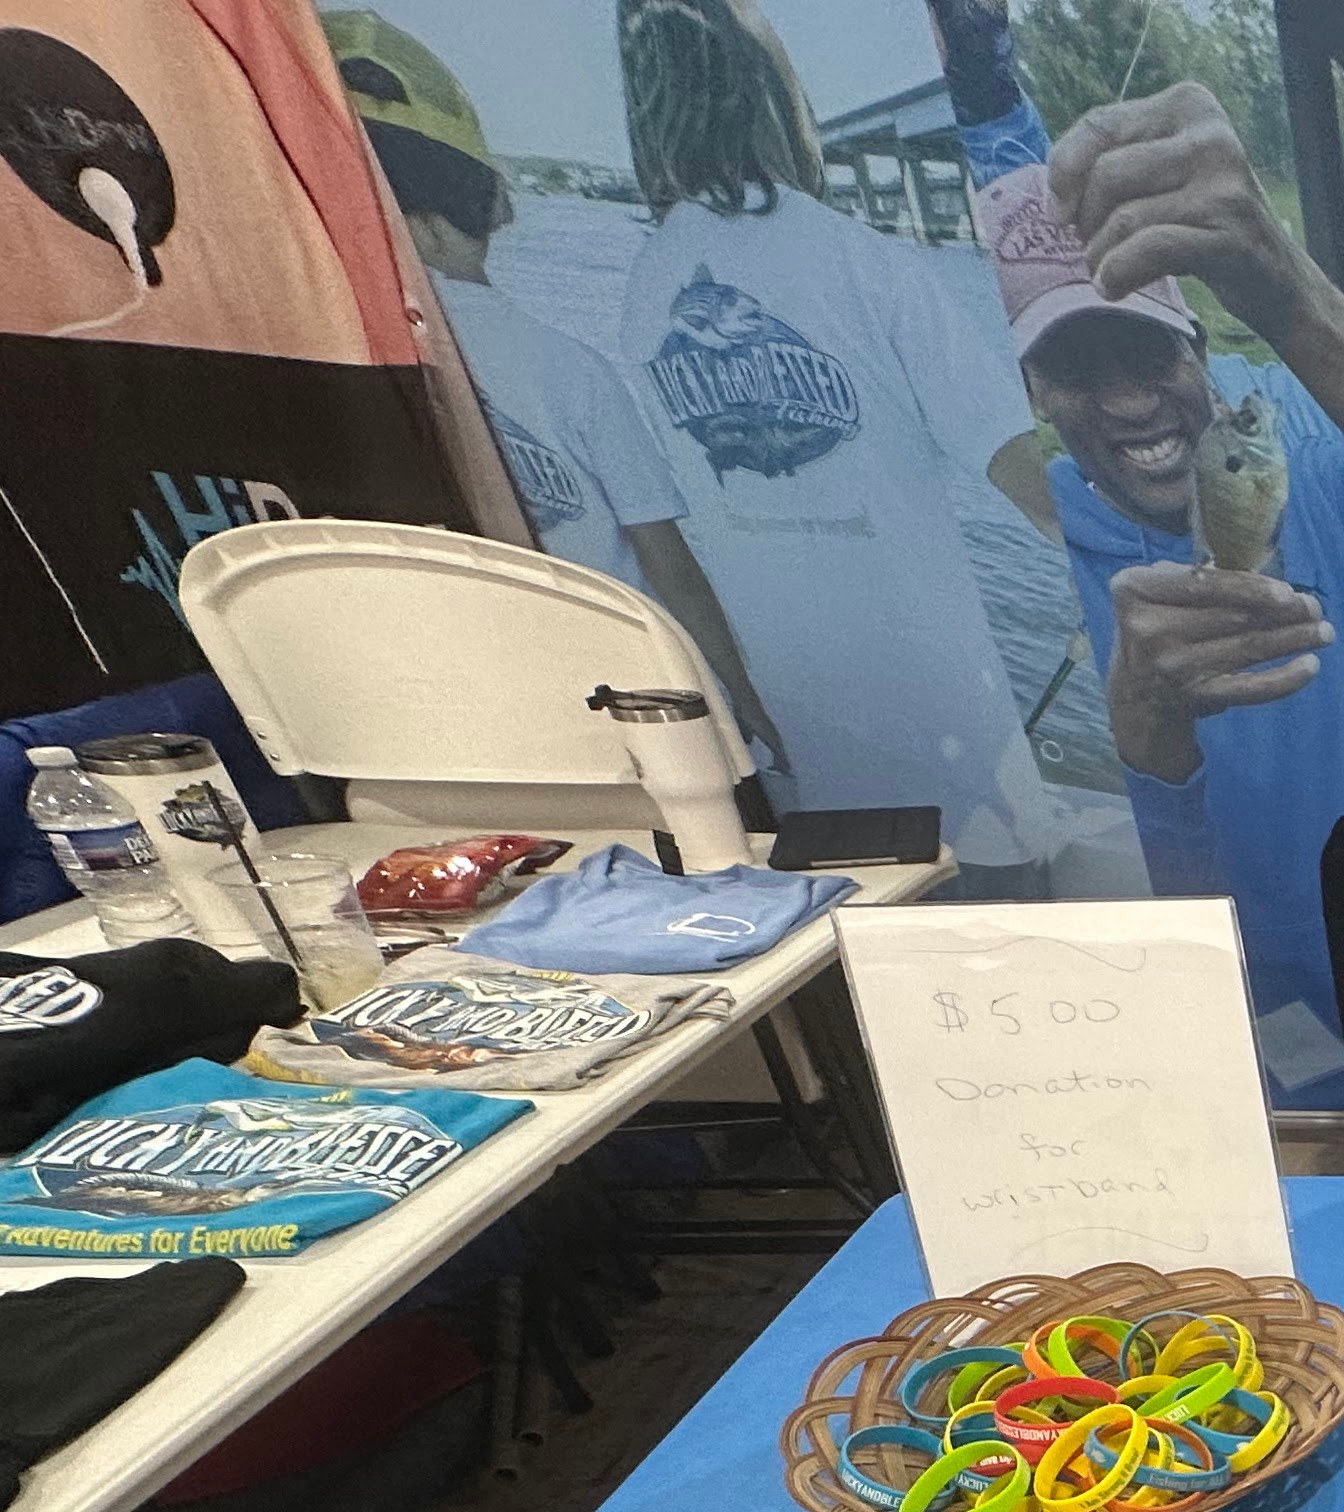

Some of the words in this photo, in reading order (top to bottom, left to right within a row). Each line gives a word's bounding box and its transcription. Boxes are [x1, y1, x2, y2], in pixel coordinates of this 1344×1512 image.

[936, 1071, 1153, 1101] Donation
[1020, 1133, 1088, 1160] for
[149, 1227, 184, 1255] for
[190, 1224, 297, 1257] Everyone
